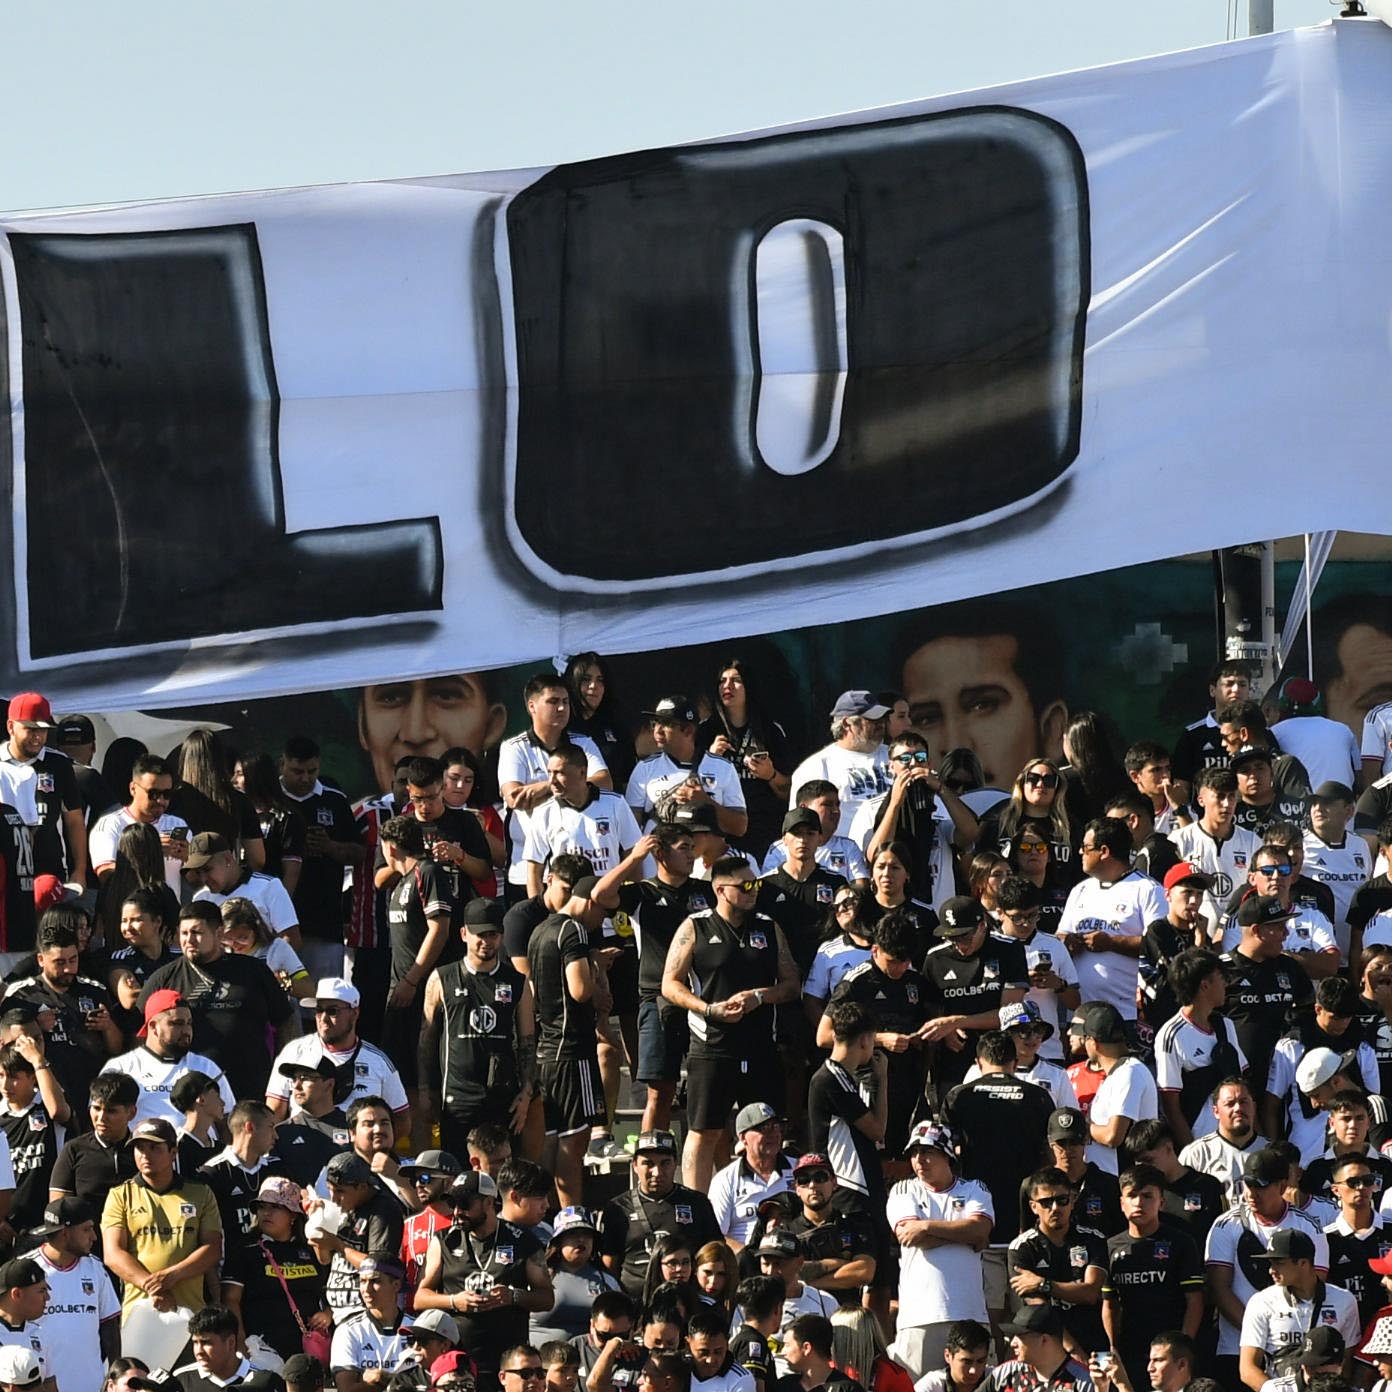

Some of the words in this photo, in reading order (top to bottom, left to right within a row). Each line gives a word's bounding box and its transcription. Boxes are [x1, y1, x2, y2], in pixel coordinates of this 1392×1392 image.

[1318, 871, 1358, 882] COOLBET
[944, 982, 986, 998] COOLBET
[471, 1006, 498, 1035] MG
[972, 1083, 1023, 1095] ASSIST
[988, 1091, 1024, 1101] CARD
